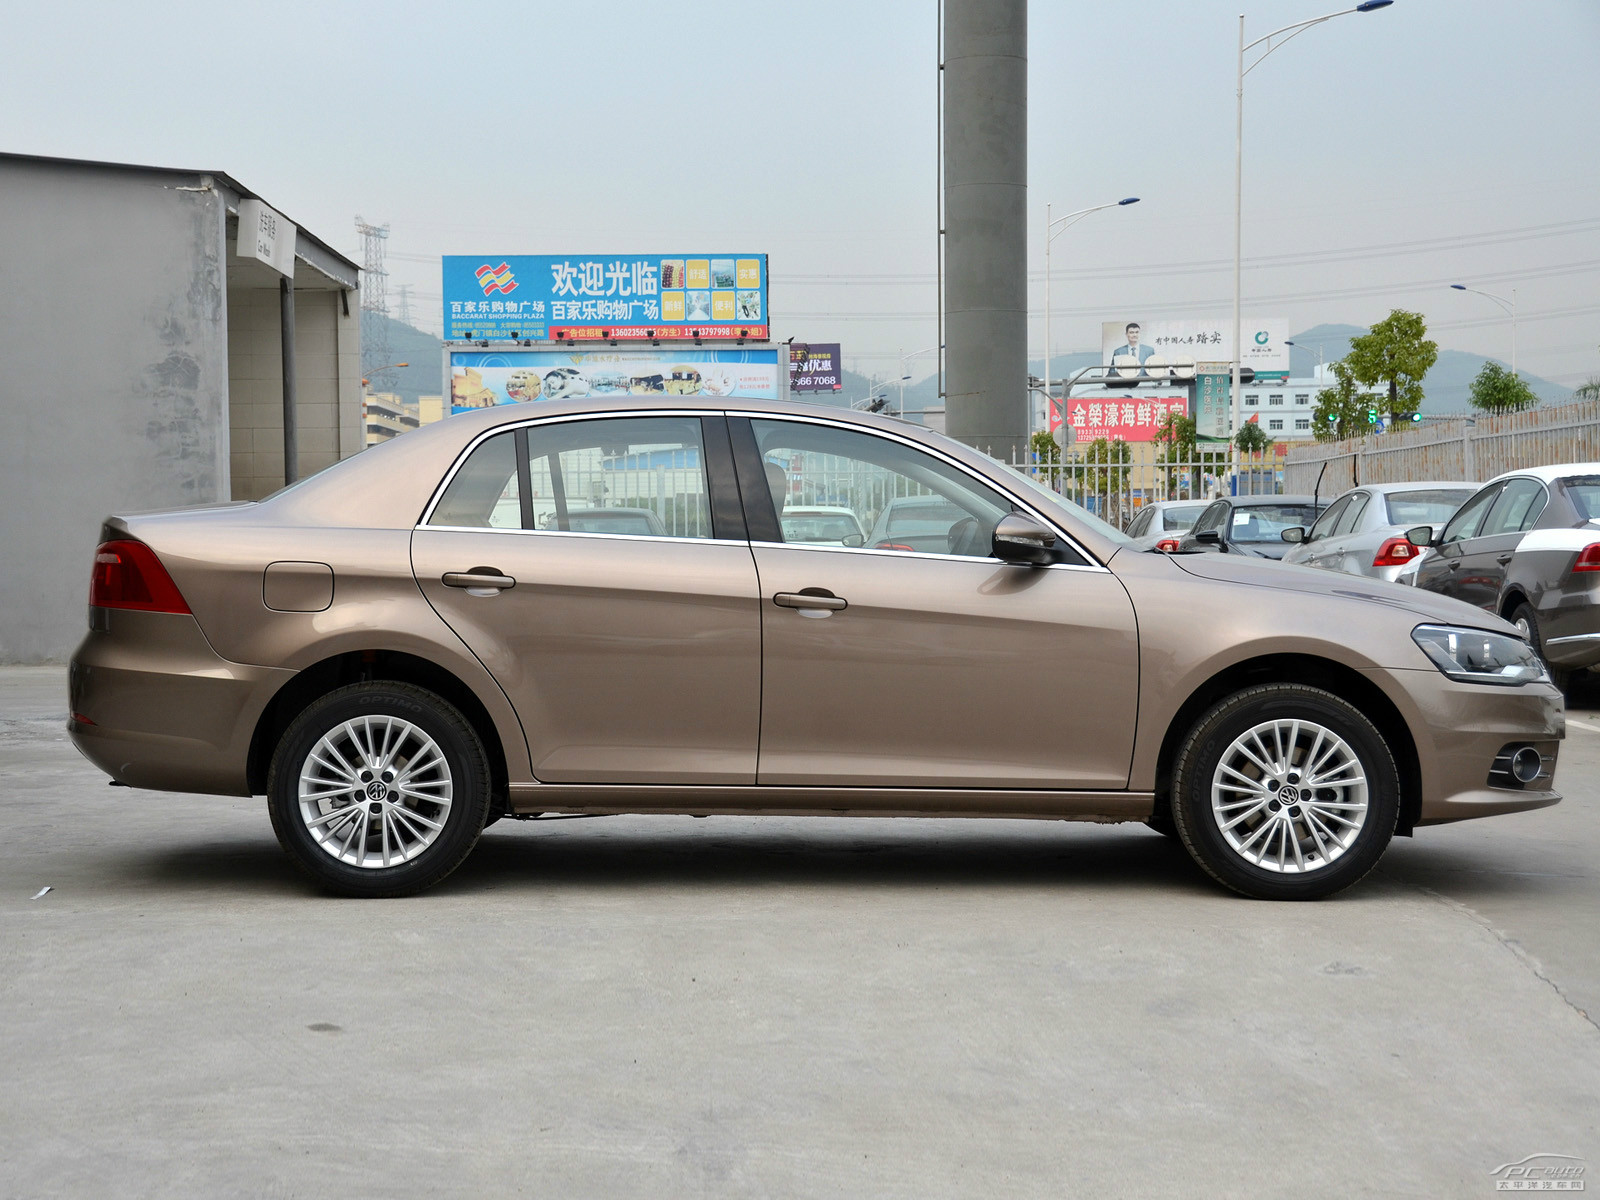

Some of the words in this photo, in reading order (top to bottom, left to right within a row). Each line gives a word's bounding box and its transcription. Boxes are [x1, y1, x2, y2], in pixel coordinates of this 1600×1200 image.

[551, 261, 658, 297] 欢迎光临
[739, 268, 757, 280] 实惠
[450, 301, 545, 313] 百家乐购物广场
[551, 300, 659, 321] 百家乐购物广场
[715, 300, 733, 311] 便利
[813, 376, 836, 385] 7068
[358, 695, 422, 713] OPTIMO
